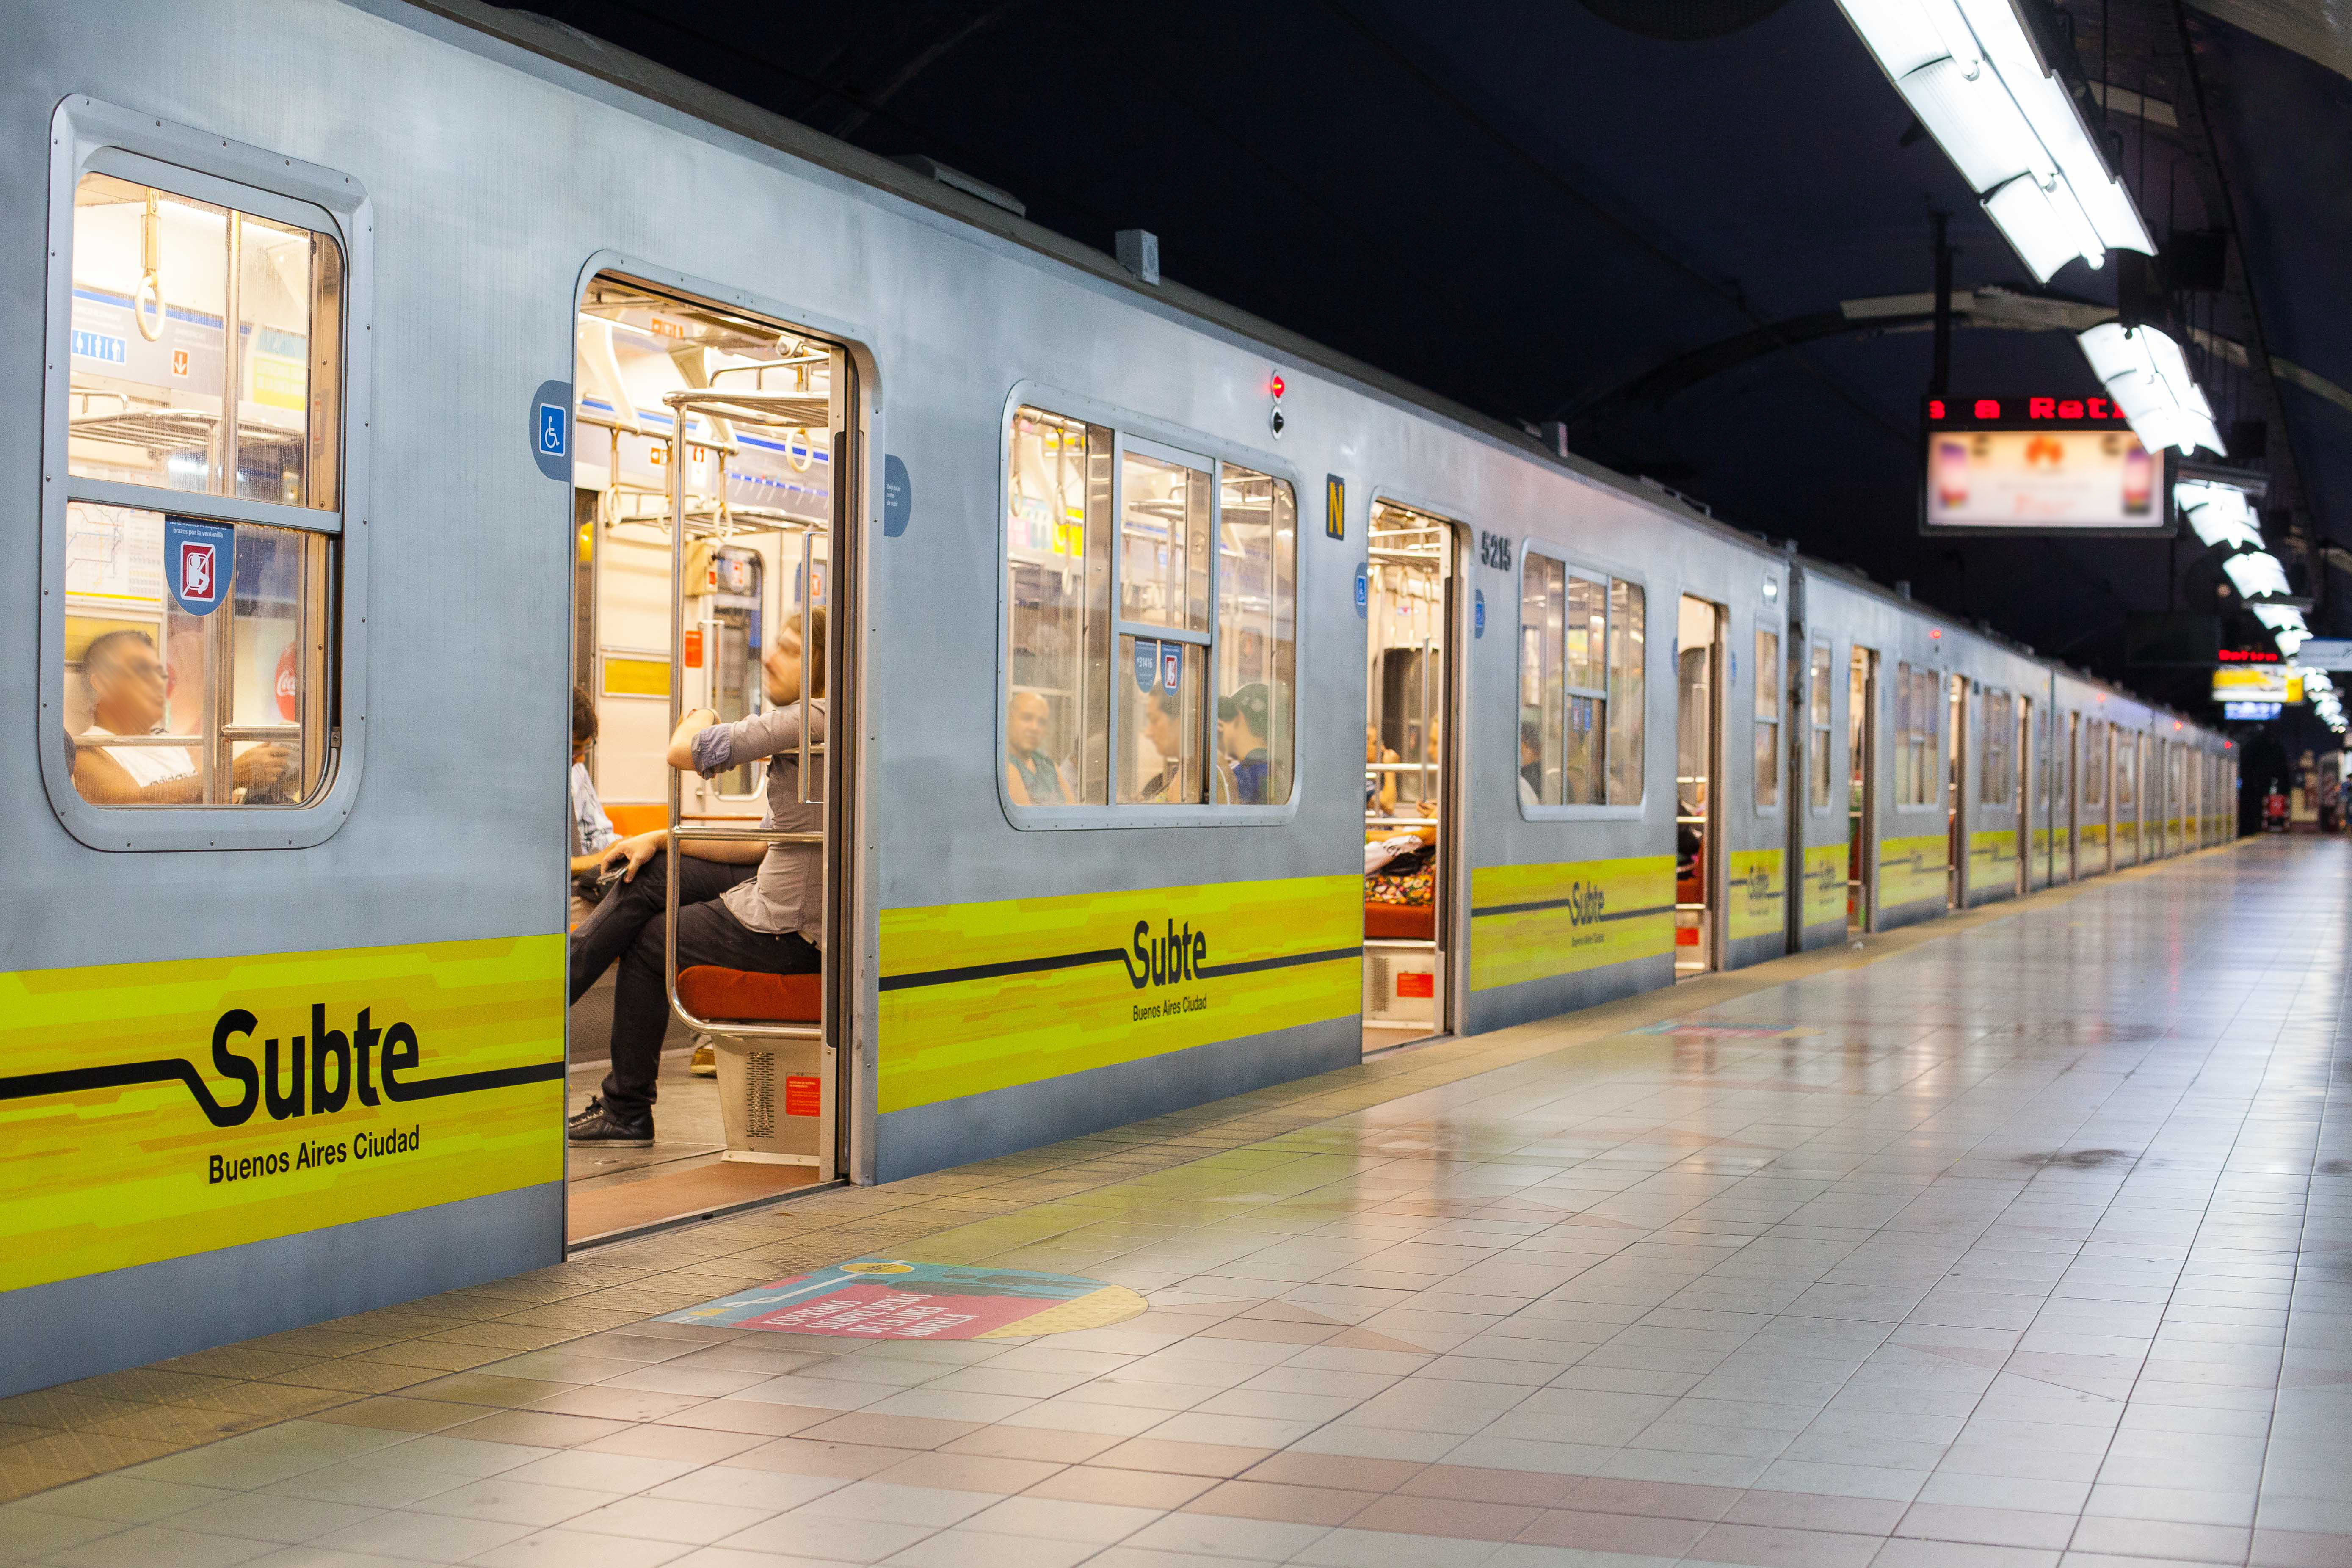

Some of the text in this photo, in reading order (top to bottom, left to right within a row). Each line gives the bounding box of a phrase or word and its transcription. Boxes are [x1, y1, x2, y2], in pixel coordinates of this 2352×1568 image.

[1329, 481, 1343, 536] N
[1481, 530, 1511, 571] 5215
[1133, 918, 1206, 989] Subte
[1133, 994, 1207, 1021] Buenos Aires Ciudad
[211, 1003, 419, 1127] Subte
[209, 1124, 420, 1184] Buenos Aires Ciudad
[762, 1299, 864, 1326] ESPEREMOS
[806, 1309, 888, 1329] SIEMPRE
[847, 1325, 893, 1333] DE
[892, 1314, 979, 1338] AMARILLA
